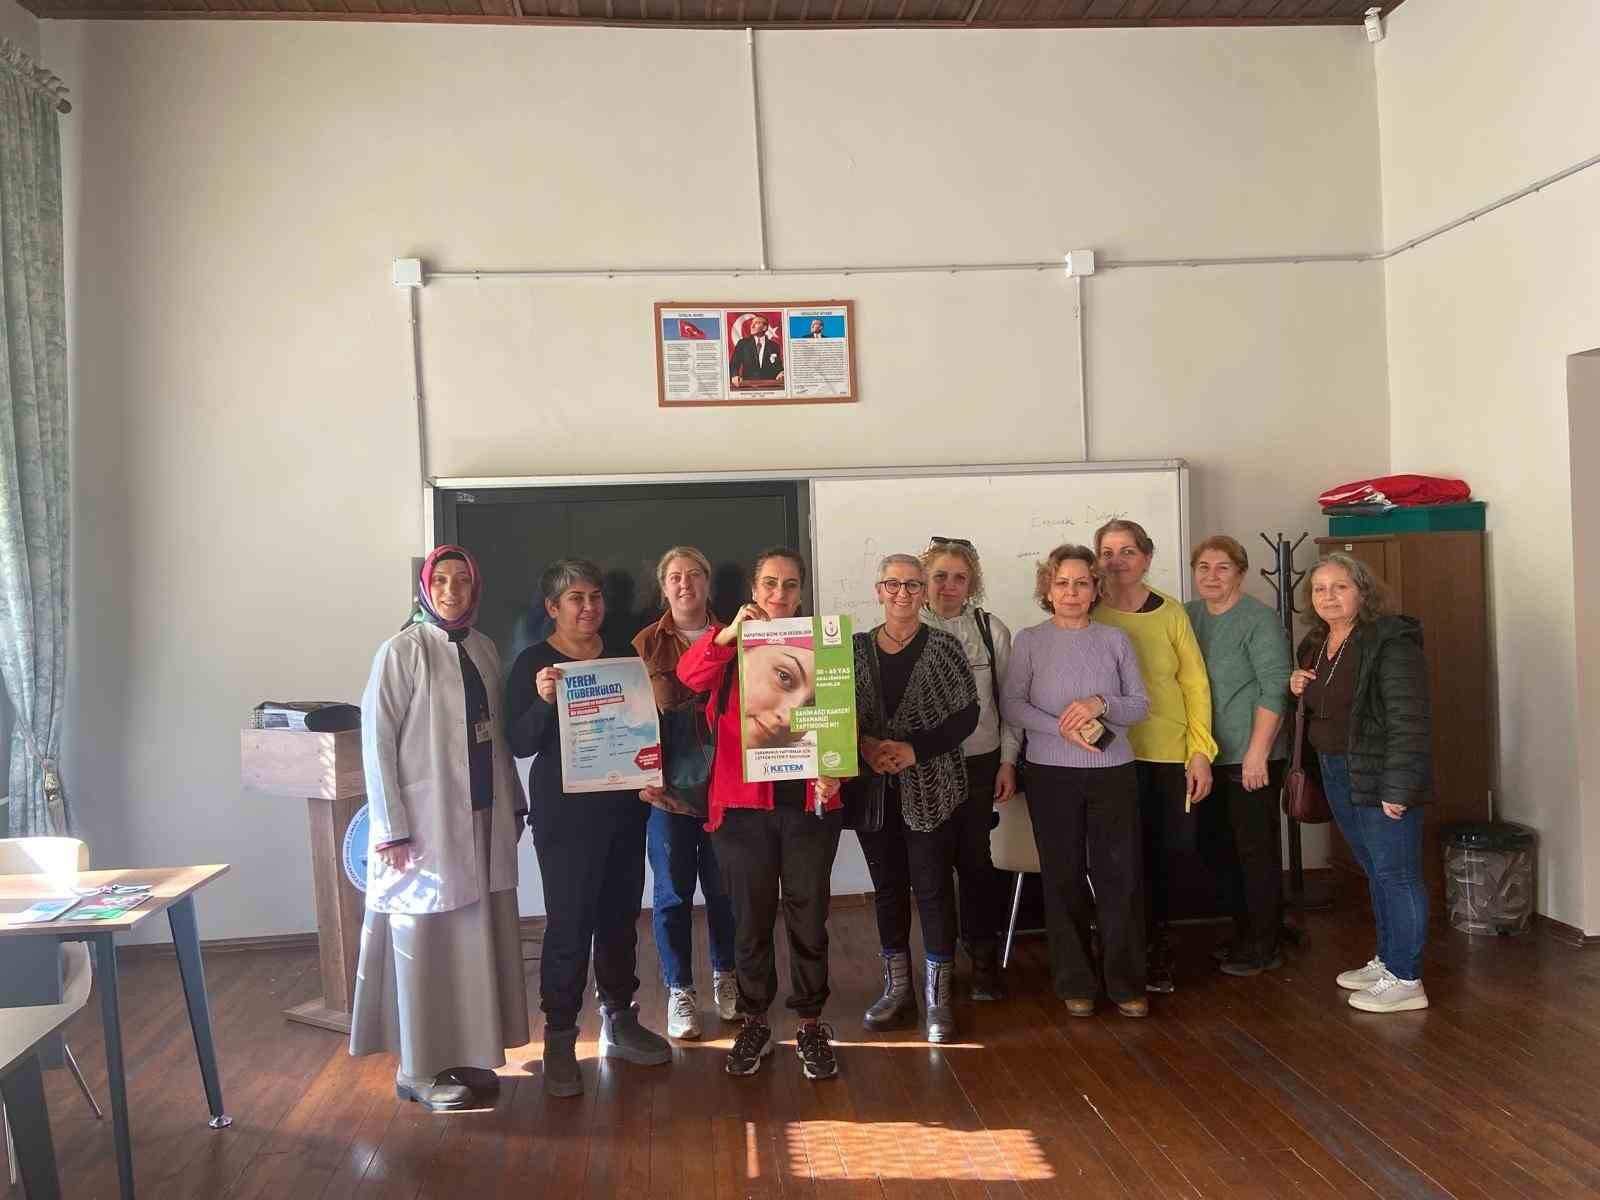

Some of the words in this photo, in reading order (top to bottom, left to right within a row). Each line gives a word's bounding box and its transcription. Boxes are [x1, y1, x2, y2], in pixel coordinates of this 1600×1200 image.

[565, 675, 597, 688] VEREM
[567, 682, 623, 701] (TÜBERKÜLOZ)
[769, 764, 804, 773] KETEM
